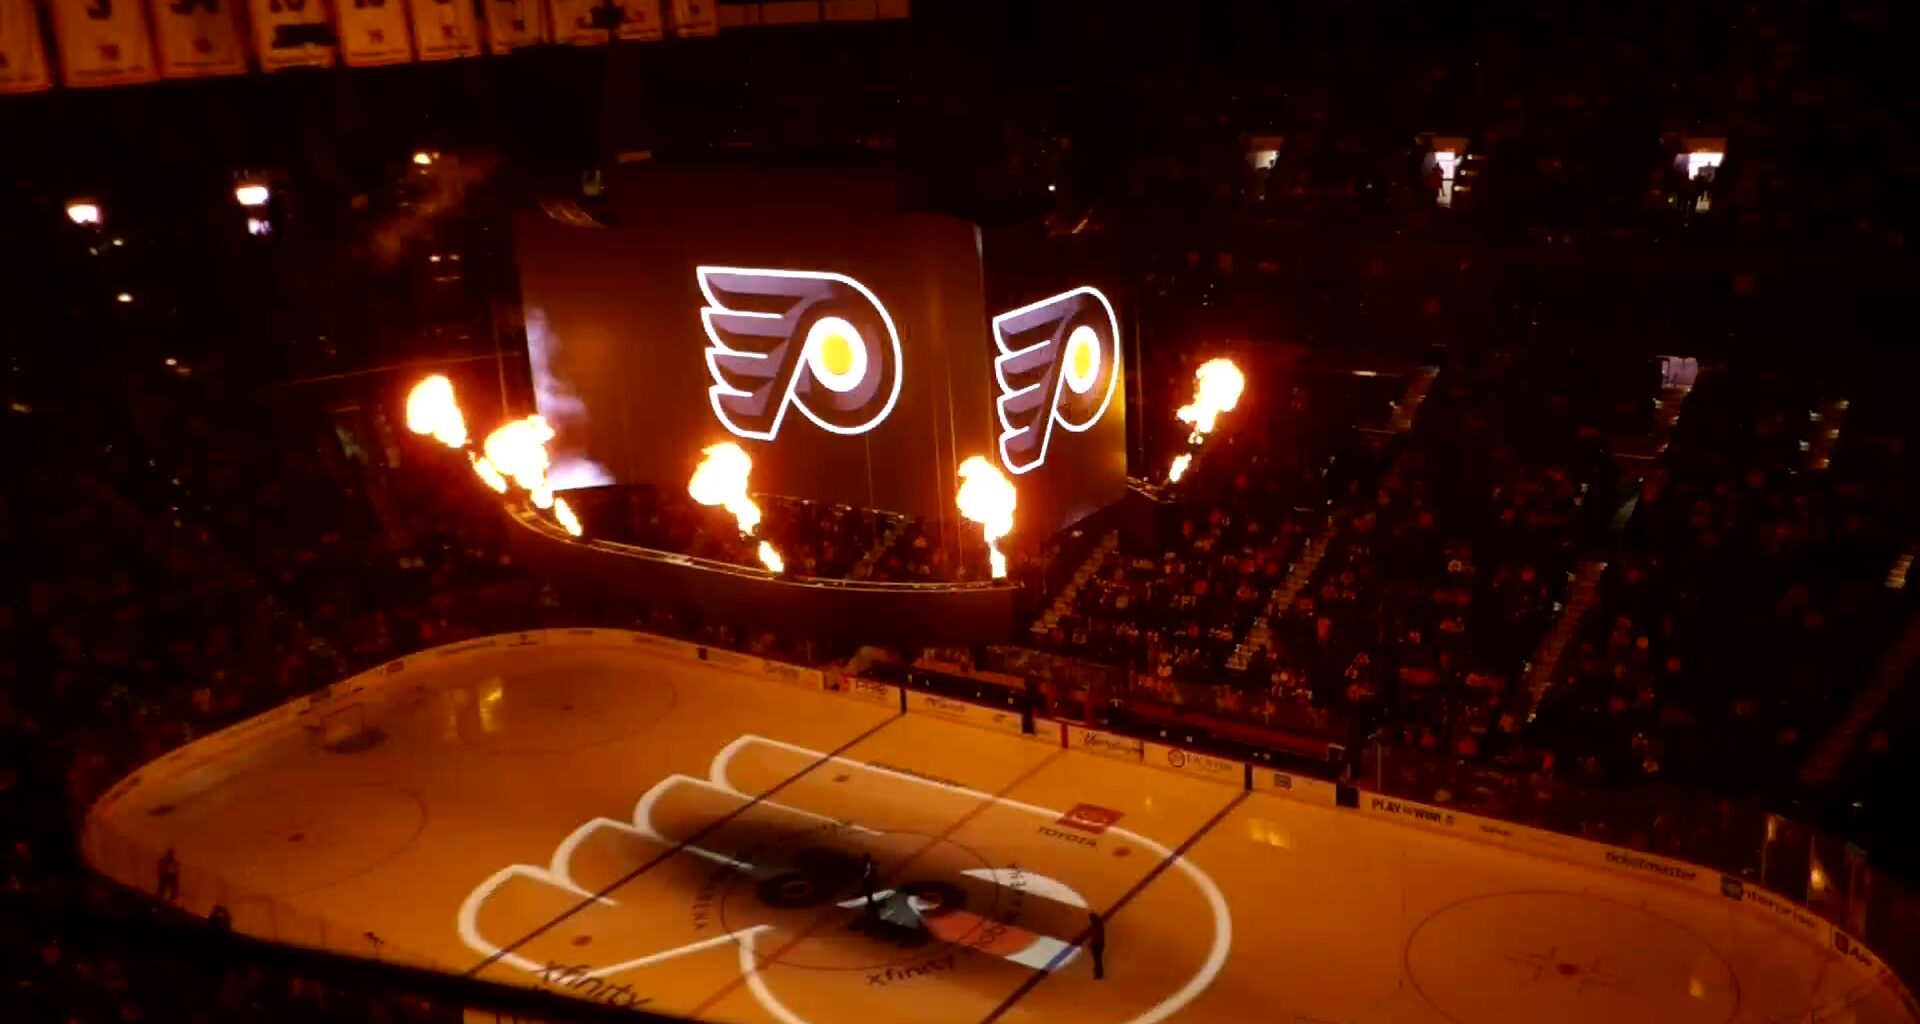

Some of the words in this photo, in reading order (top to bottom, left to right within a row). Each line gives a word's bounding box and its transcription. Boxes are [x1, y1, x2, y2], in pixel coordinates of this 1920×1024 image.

[1372, 797, 1401, 813] PLAY
[1036, 824, 1097, 848] TOYOTA
[536, 959, 654, 1009] xfinity
[866, 953, 955, 988] xfinity
